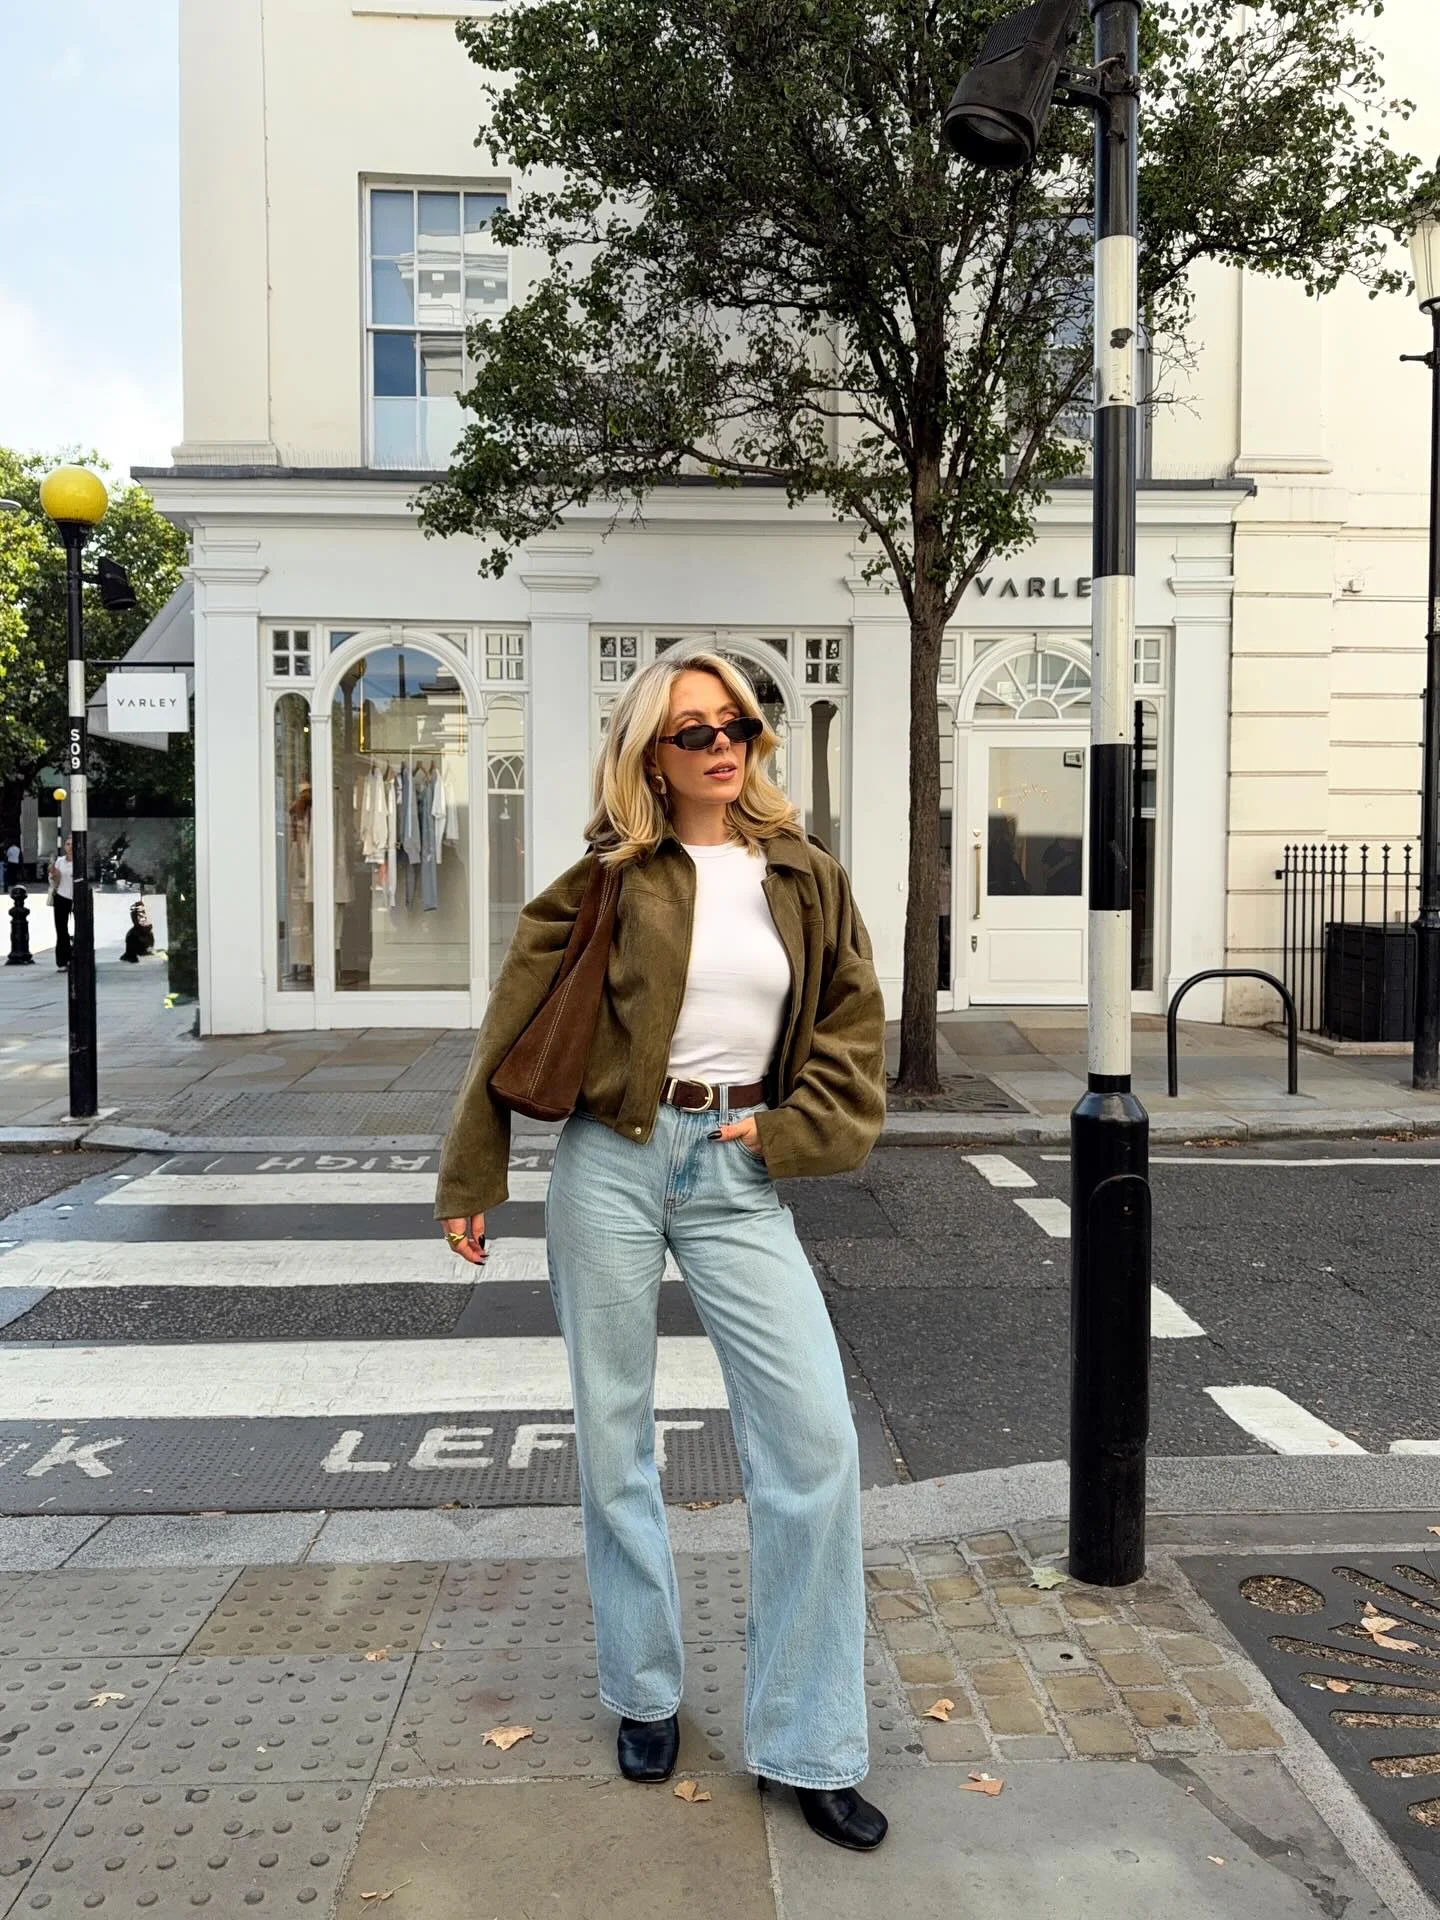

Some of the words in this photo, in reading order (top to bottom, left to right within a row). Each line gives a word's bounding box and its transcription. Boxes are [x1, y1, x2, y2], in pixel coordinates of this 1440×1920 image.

[974, 576, 1093, 598] VARLE
[116, 698, 177, 708] VARLEY
[203, 1154, 431, 1171] RIGH
